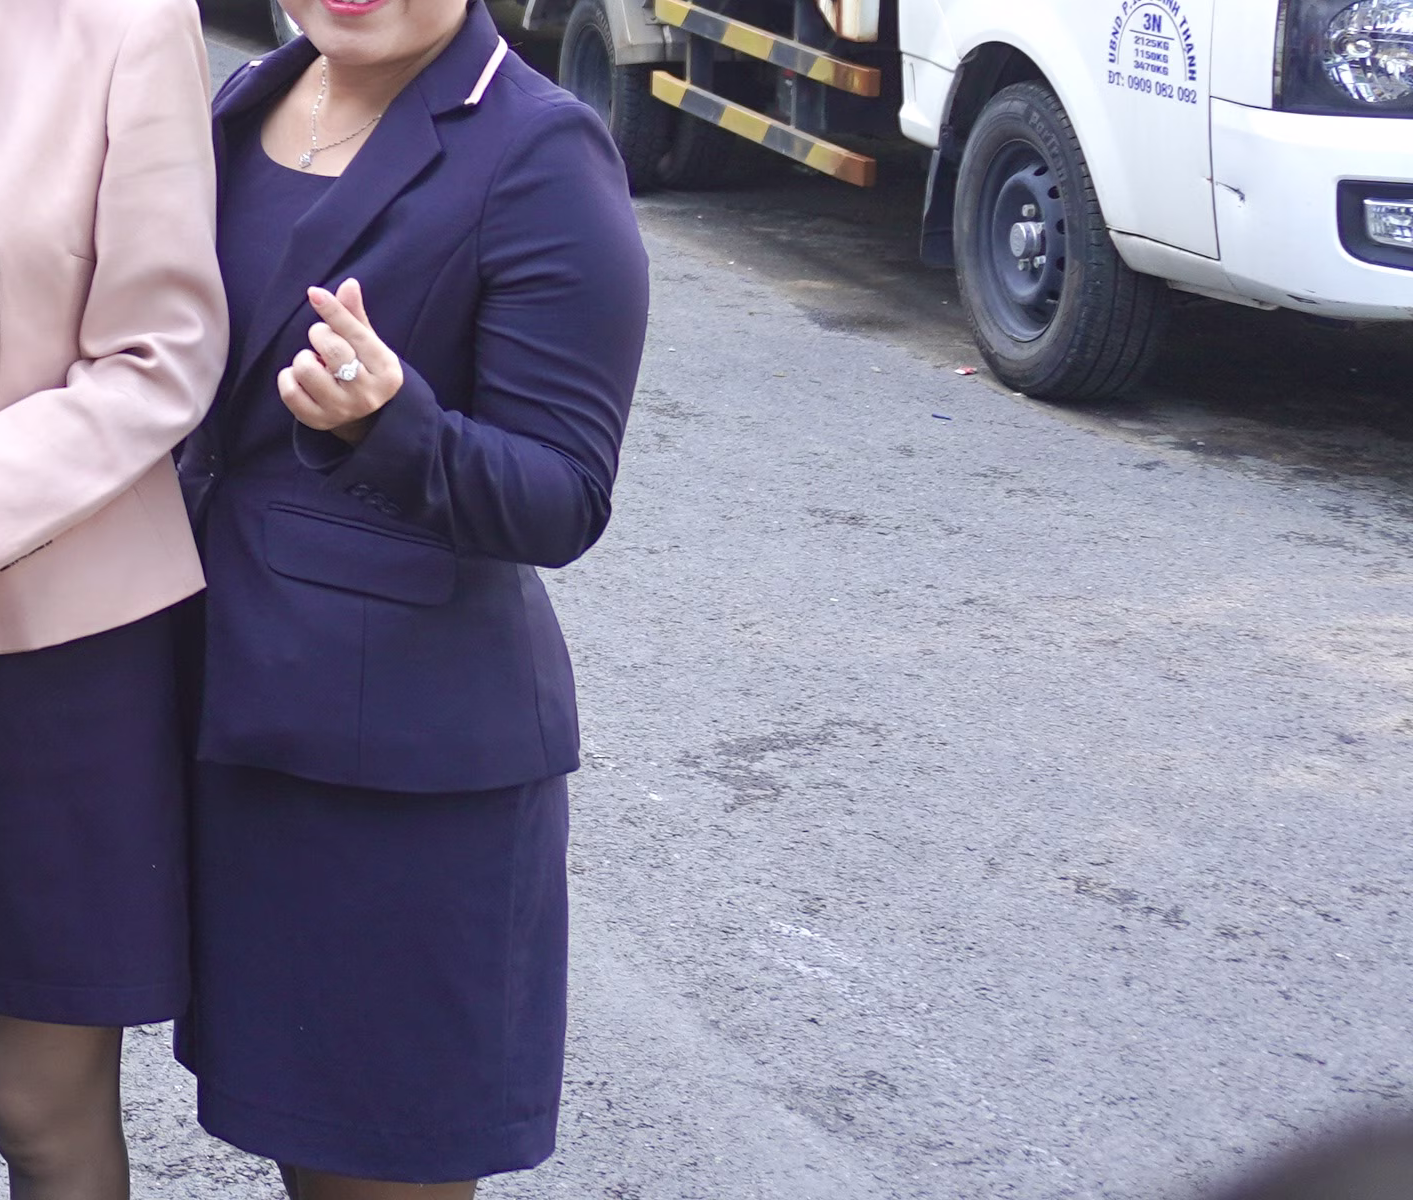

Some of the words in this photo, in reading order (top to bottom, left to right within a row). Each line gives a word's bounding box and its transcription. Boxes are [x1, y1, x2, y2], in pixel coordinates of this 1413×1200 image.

[1143, 12, 1162, 33] 3N
[1108, 16, 1123, 63] UBND
[1134, 35, 1170, 51] 2125KG
[1134, 48, 1169, 64] 1150KG
[1133, 60, 1169, 76] 3470KG
[1127, 75, 1152, 94] 0909
[1155, 81, 1174, 99] 082
[1177, 86, 1197, 105] 092
